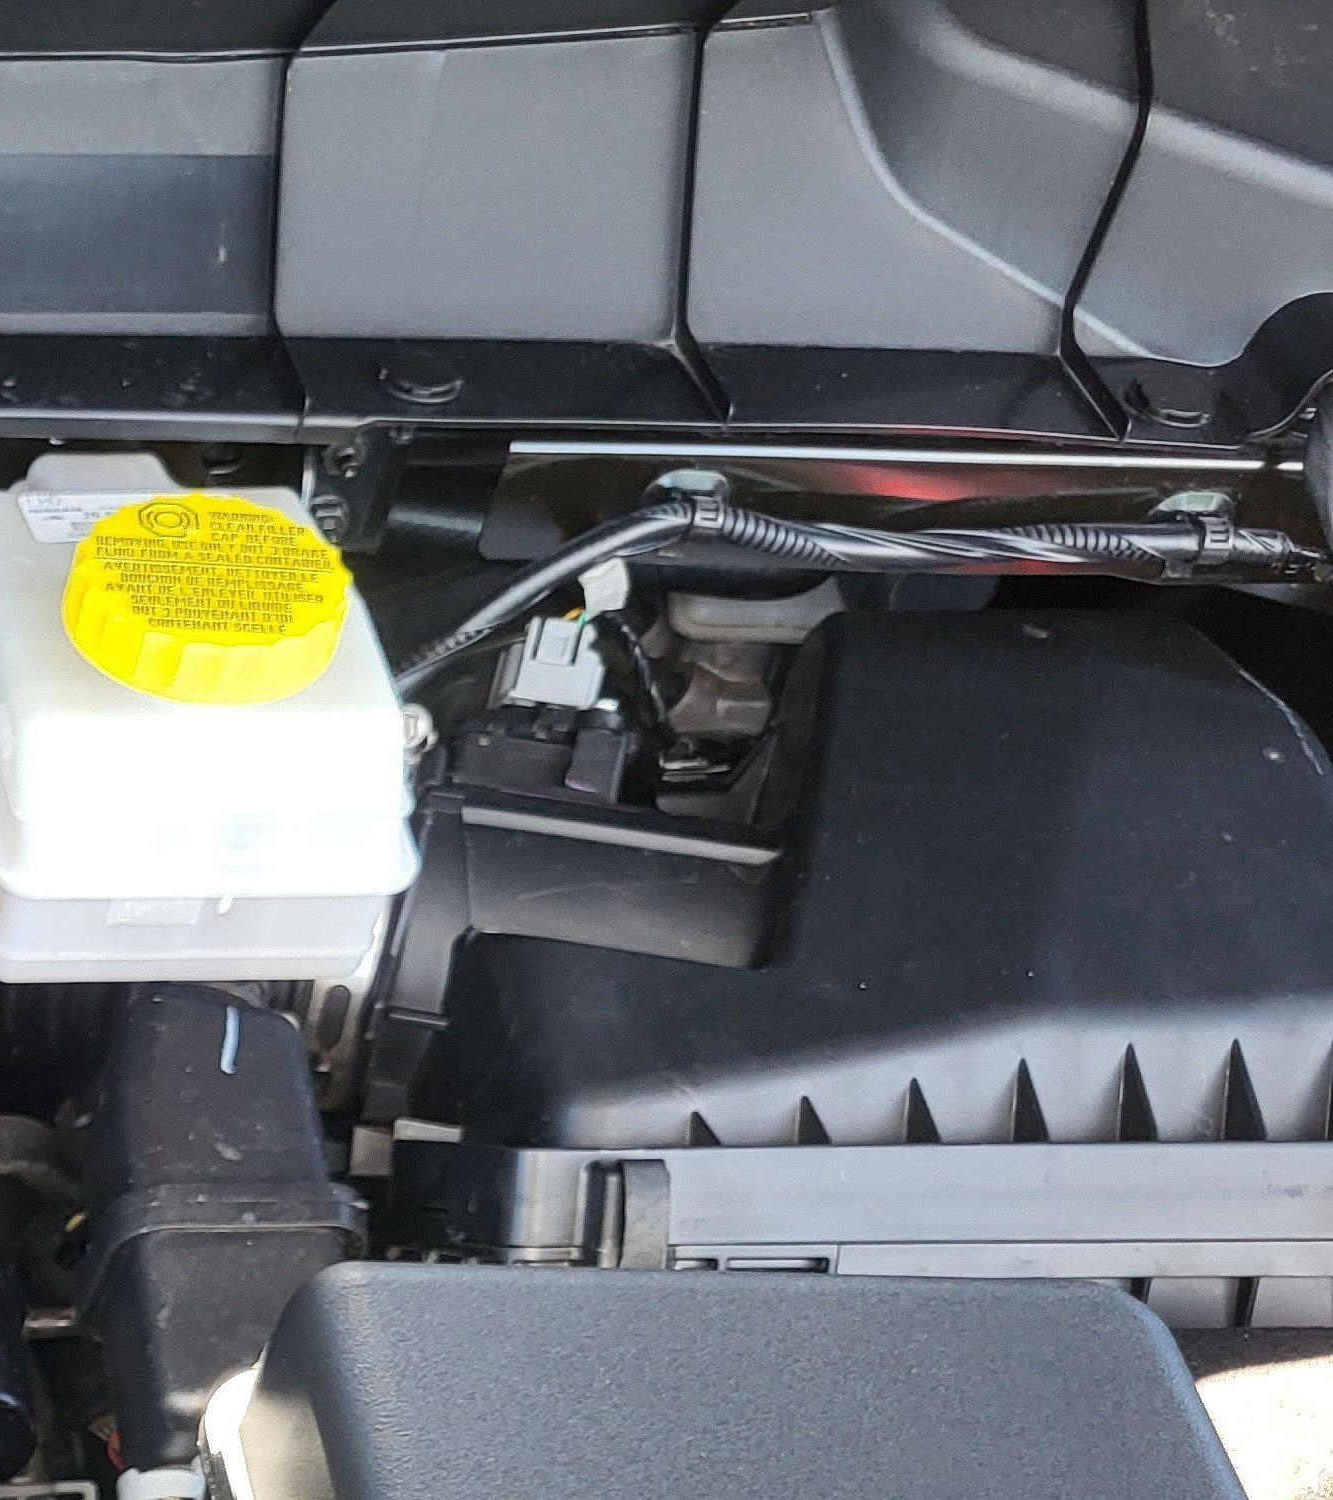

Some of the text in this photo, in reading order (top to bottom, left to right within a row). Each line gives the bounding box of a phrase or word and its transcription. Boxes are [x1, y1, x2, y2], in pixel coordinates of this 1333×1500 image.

[210, 521, 254, 534] CLEAN
[211, 532, 296, 545] CAP BEFORE
[171, 540, 197, 551] USE
[240, 544, 264, 555] DOT
[282, 548, 329, 560] BRAKE
[140, 550, 179, 561] FROM
[183, 551, 193, 561] A
[198, 552, 252, 563] SEALED
[186, 576, 202, 586] DE
[301, 573, 319, 582] LE
[105, 583, 153, 595] AVANT
[158, 585, 175, 595] DE
[216, 599, 235, 609] DU
[131, 605, 157, 616] DOT
